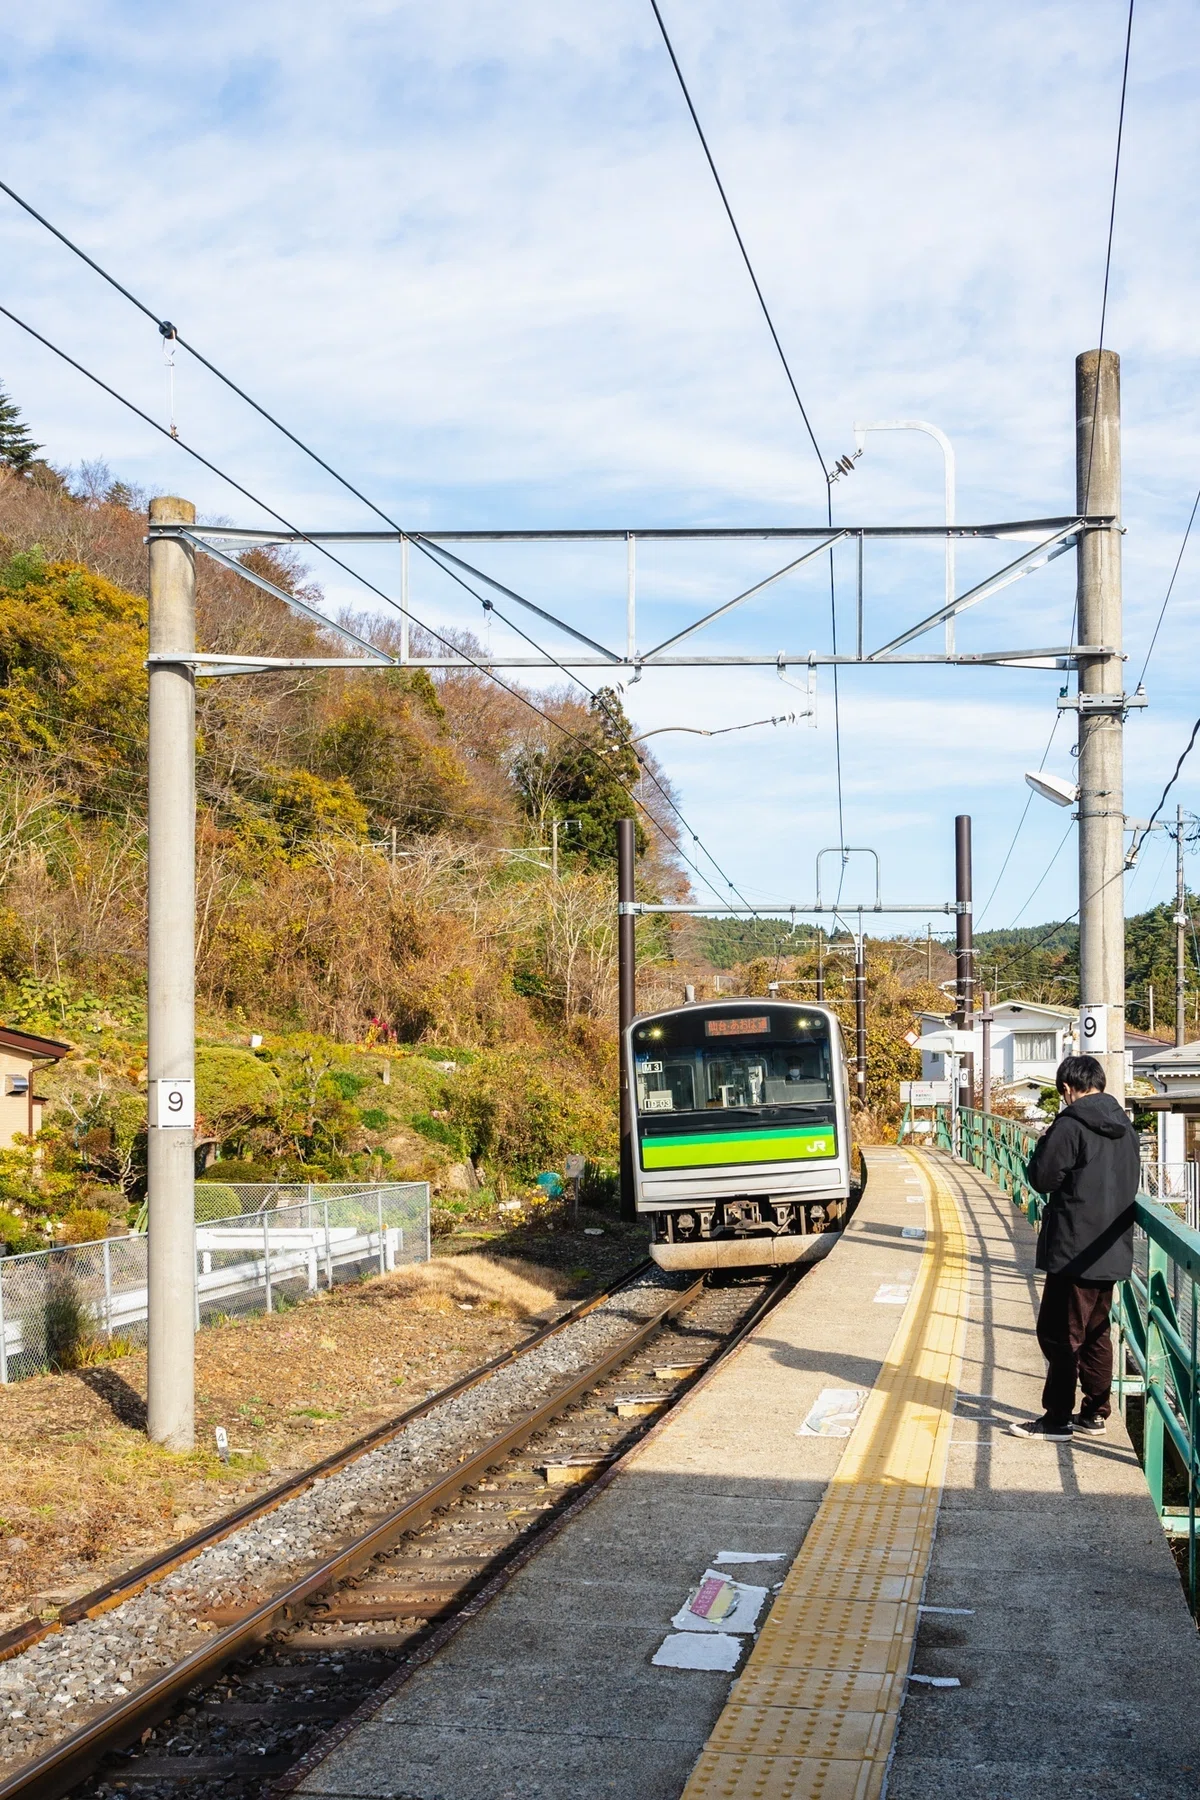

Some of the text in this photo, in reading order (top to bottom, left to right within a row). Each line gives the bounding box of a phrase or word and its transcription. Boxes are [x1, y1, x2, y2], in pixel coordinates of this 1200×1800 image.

[1084, 1016, 1097, 1038] 9
[168, 1091, 184, 1112] 9
[807, 1140, 826, 1153] JR
[218, 1433, 225, 1442] 4
